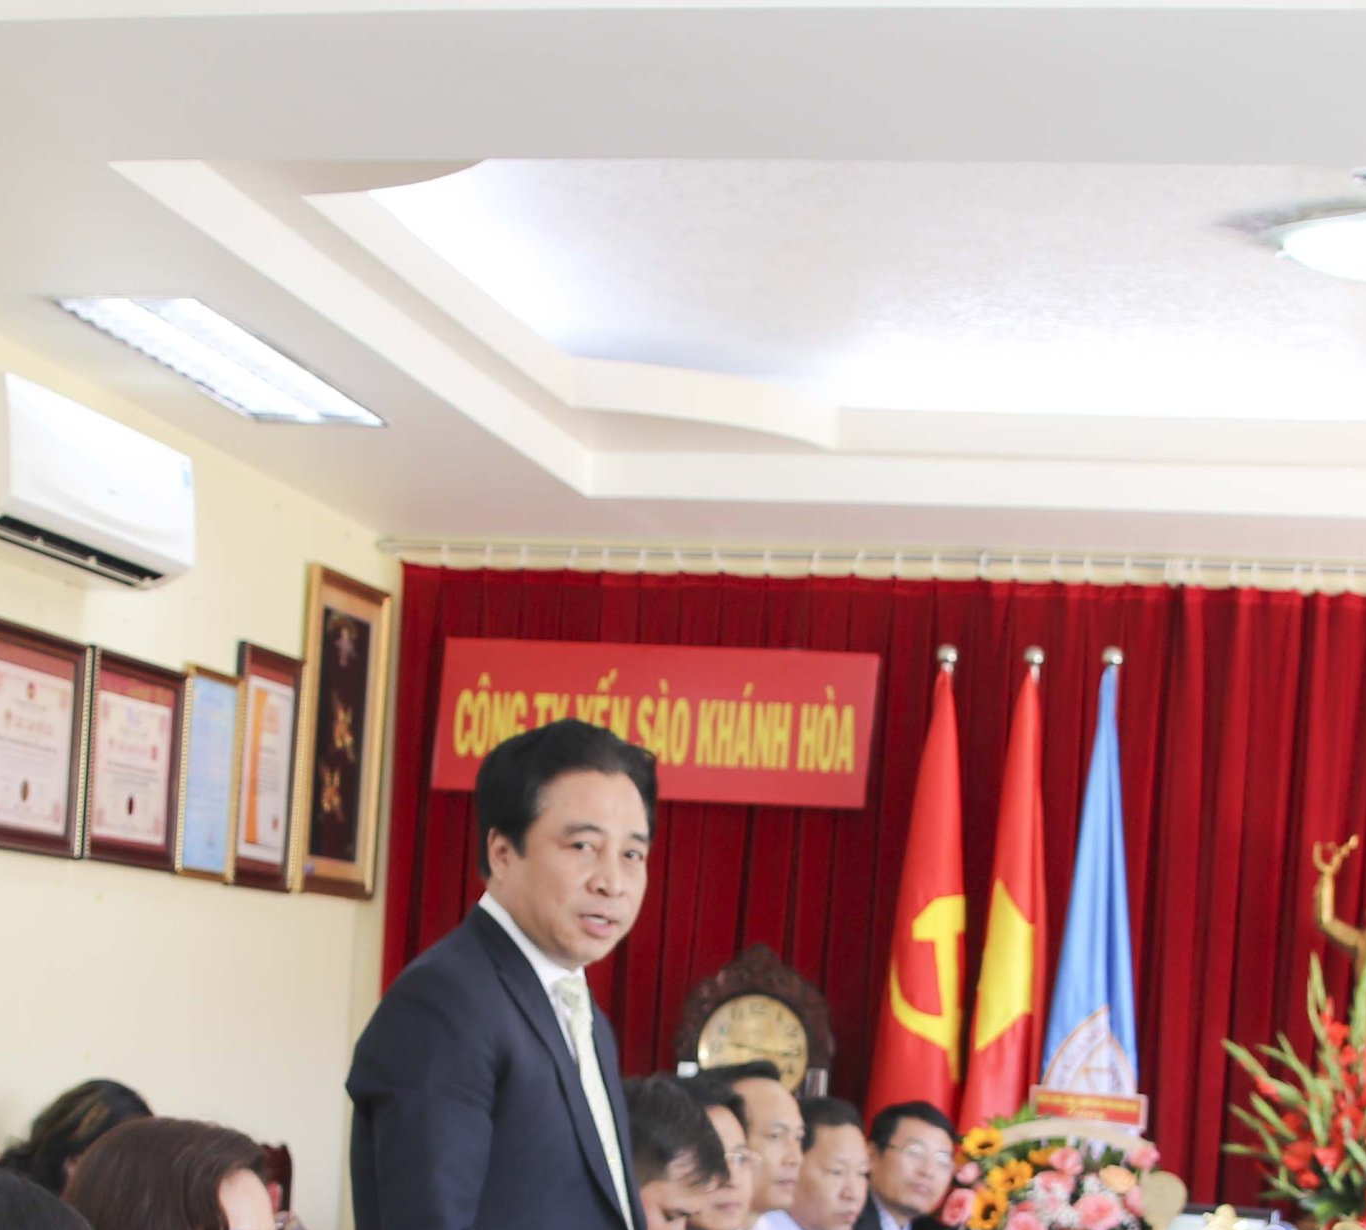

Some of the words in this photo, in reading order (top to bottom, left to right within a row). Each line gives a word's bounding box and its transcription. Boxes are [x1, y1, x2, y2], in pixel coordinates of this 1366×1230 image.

[453, 672, 528, 758] CÔNG
[636, 678, 691, 766] SÀO
[695, 682, 793, 770] KHÁNH
[796, 685, 856, 774] HÒA
